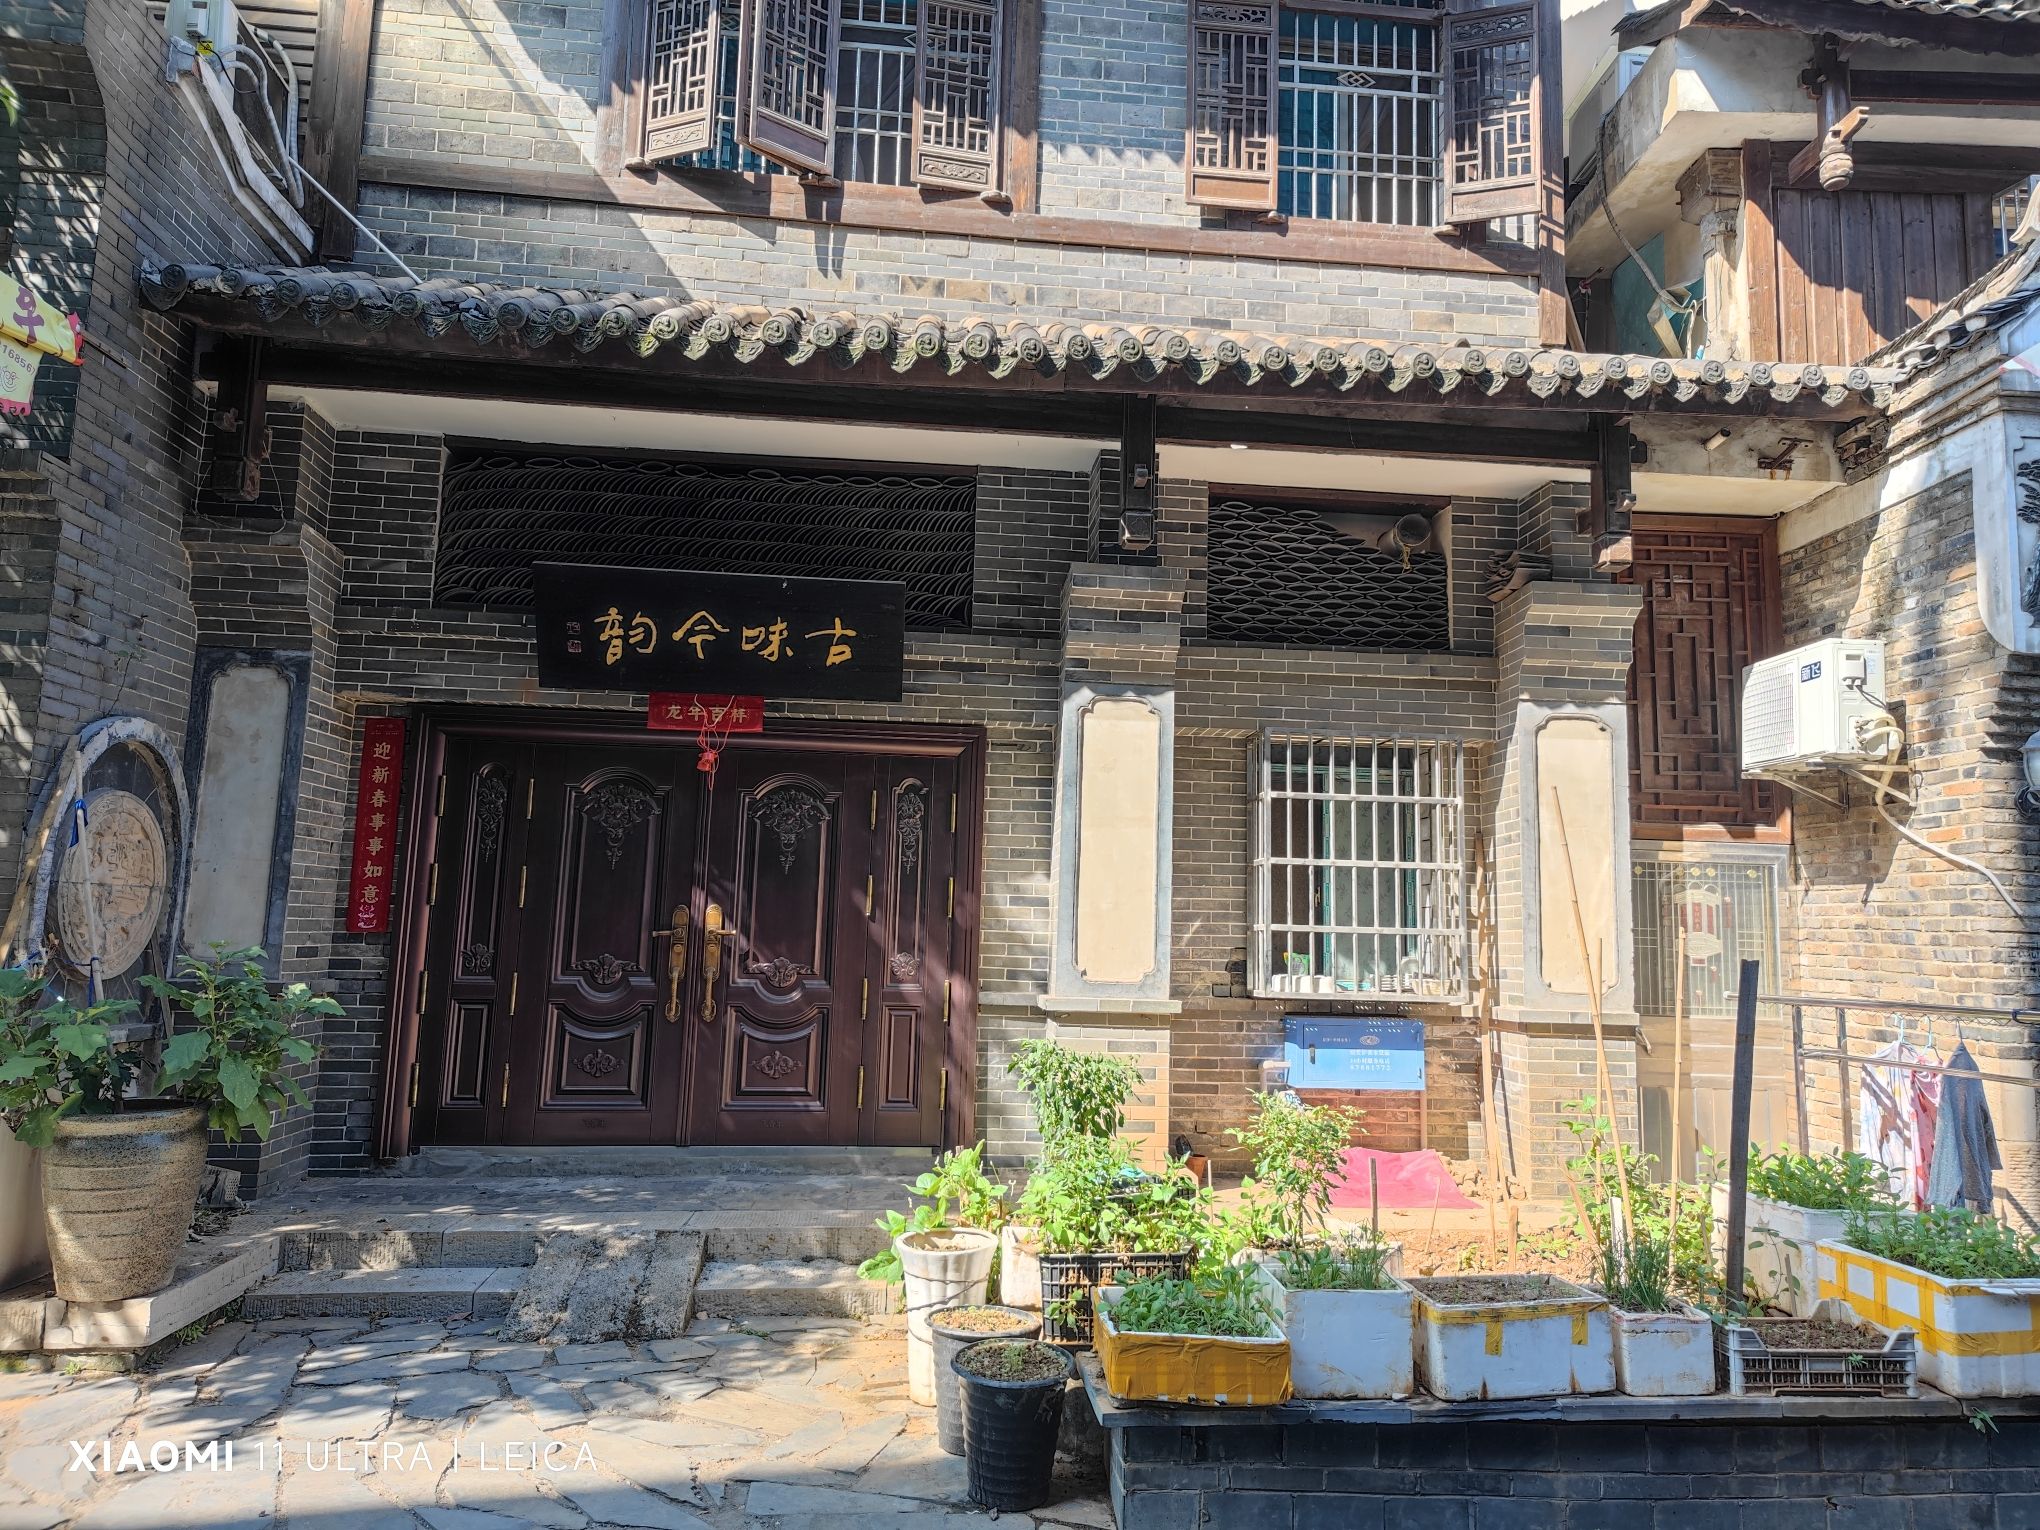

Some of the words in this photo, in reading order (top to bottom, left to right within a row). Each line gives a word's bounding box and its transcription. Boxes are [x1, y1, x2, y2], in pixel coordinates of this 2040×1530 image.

[665, 704, 748, 724] 龙年吉祥
[360, 742, 391, 904] 迎新春事事如意
